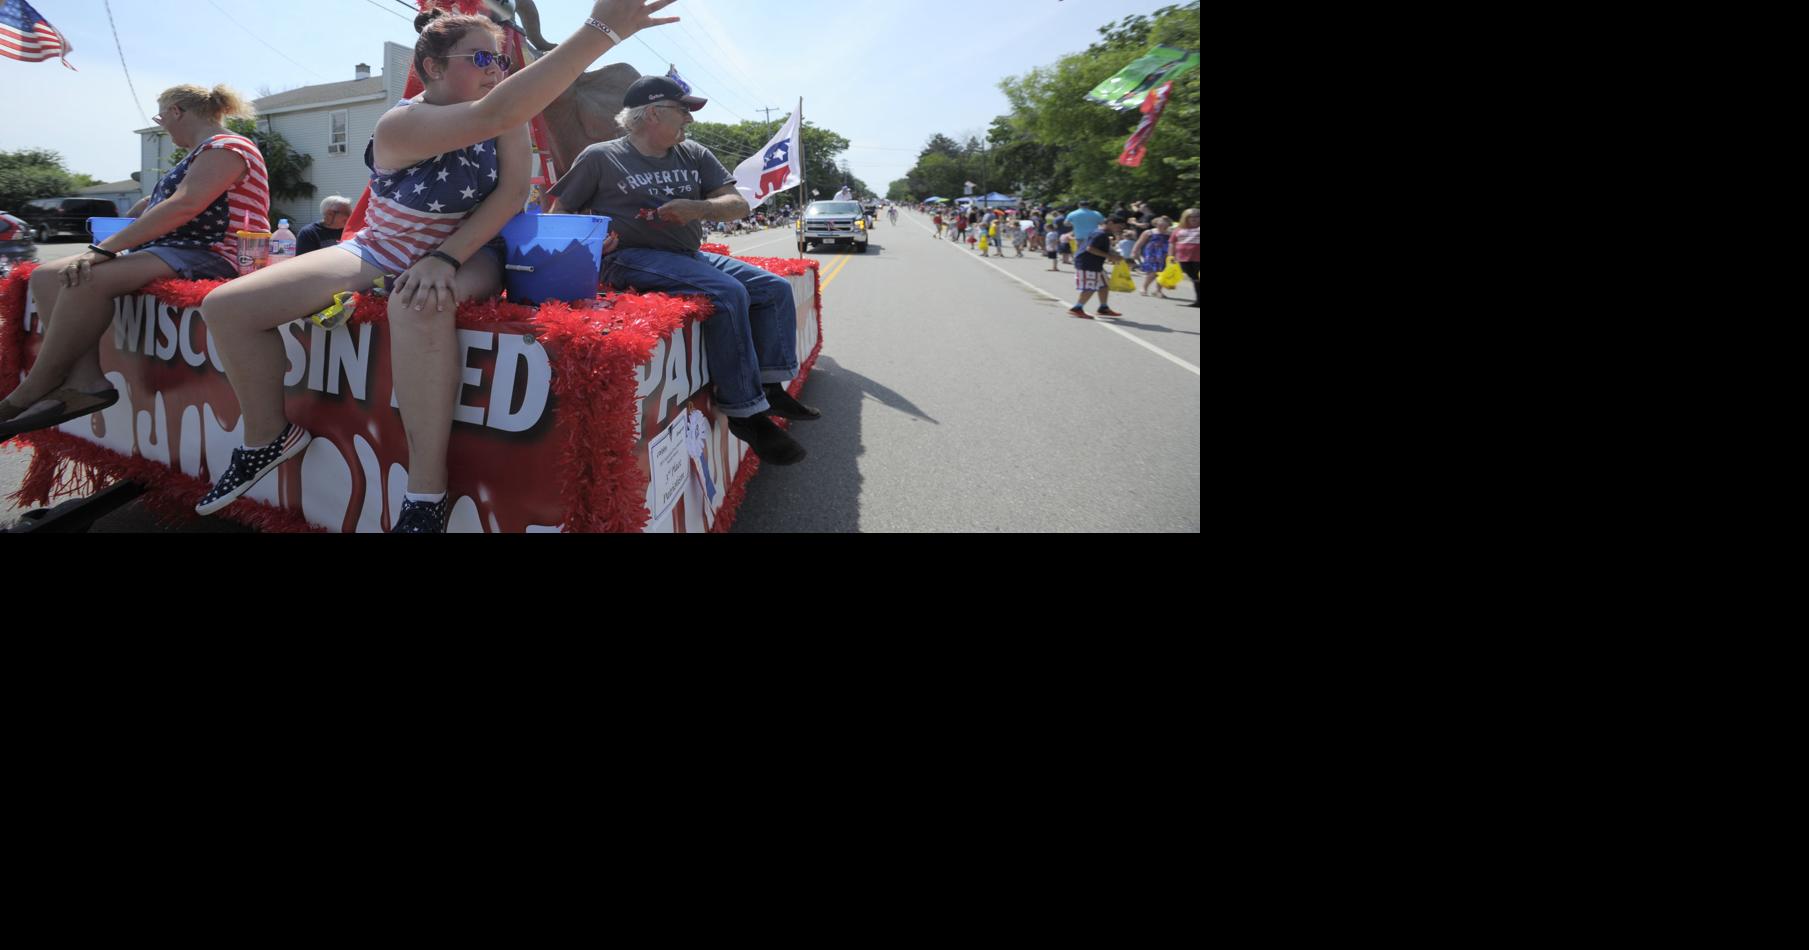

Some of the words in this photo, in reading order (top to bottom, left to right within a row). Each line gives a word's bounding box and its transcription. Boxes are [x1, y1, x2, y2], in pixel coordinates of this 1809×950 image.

[616, 169, 688, 195] PROPERTY
[113, 294, 373, 401] WISCSIN
[390, 329, 552, 432] ED
[634, 319, 710, 440] PAI
